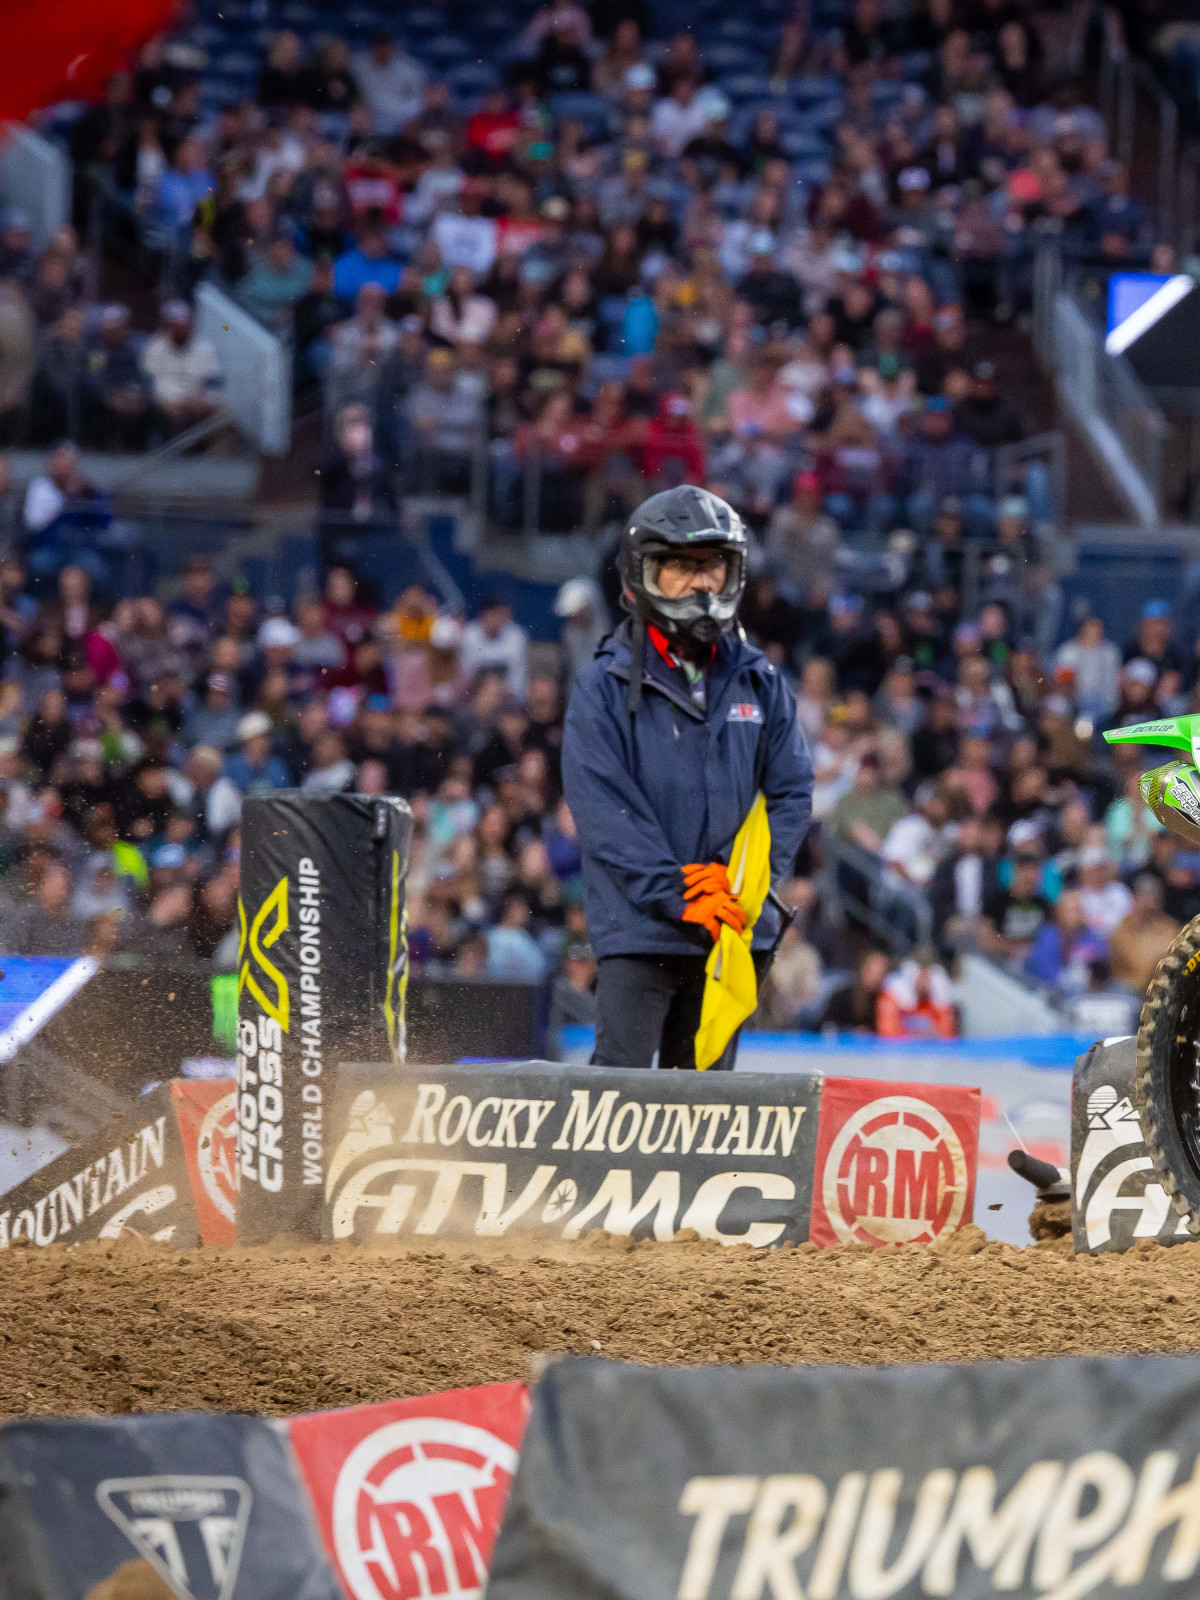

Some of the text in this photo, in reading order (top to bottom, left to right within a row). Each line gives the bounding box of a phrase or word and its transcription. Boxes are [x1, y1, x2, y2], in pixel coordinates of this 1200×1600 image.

[1132, 724, 1175, 734] DUNLOP
[299, 857, 322, 1185] WORLD CHAMPIONSHIP
[238, 1019, 258, 1182] MOTO
[258, 1015, 283, 1193] CROSS
[402, 1083, 807, 1157] ROCKY MOUNTAIN
[856, 1147, 941, 1221] RM
